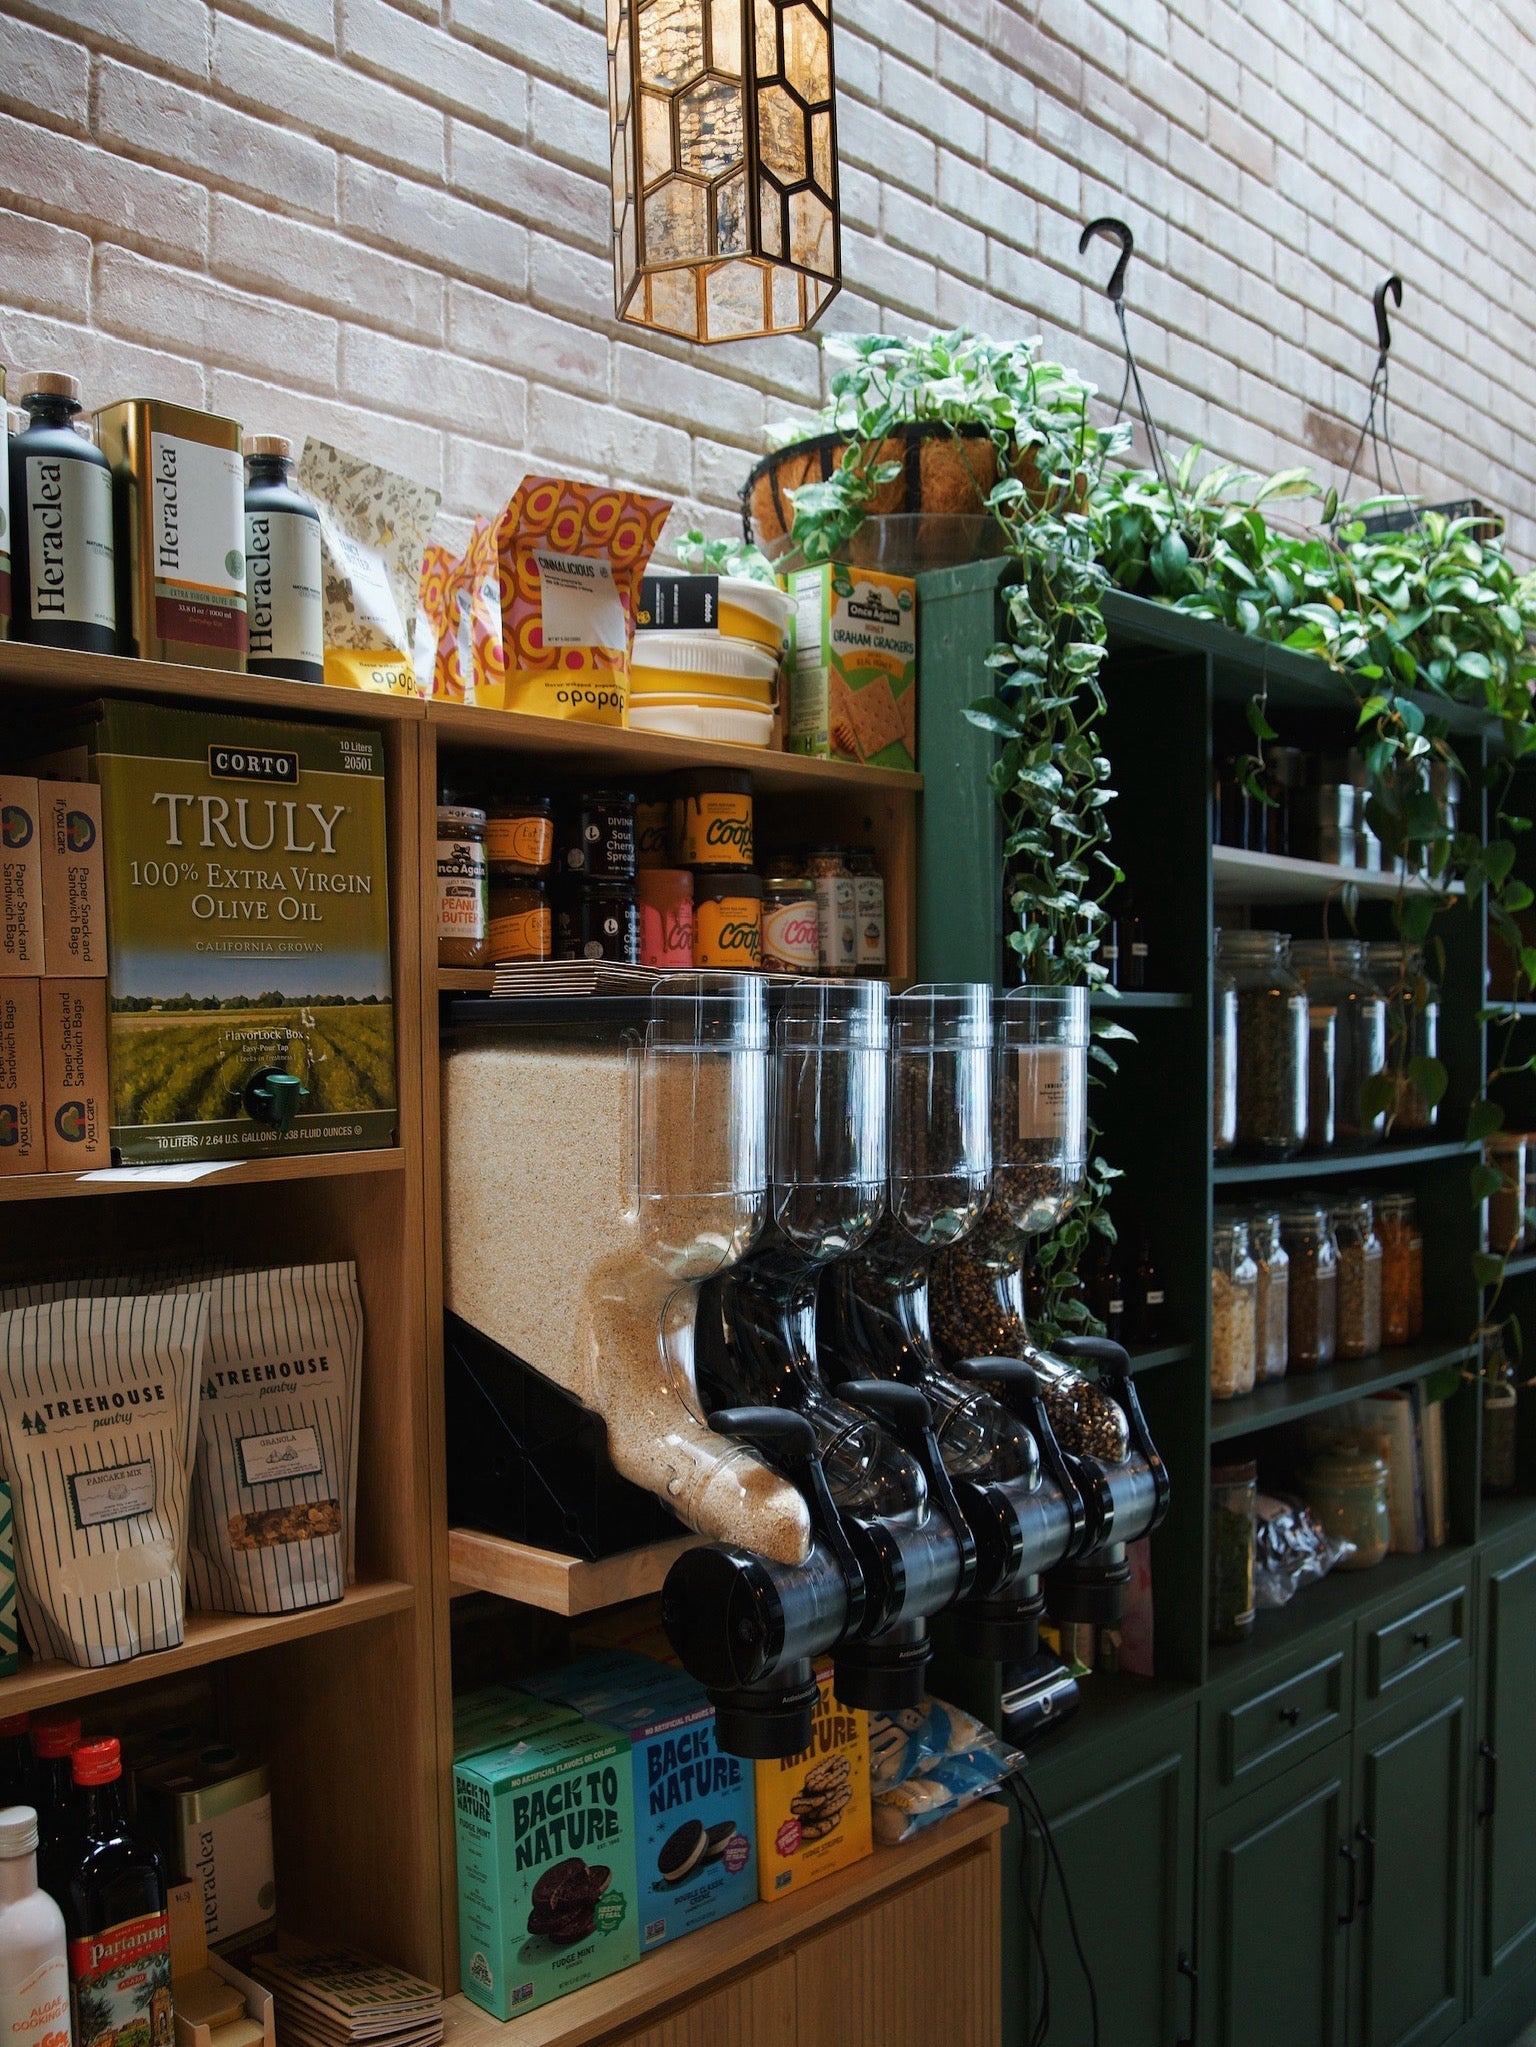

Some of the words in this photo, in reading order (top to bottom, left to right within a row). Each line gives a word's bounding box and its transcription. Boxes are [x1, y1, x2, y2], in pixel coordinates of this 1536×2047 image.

[156, 448, 179, 570] Heraclea
[33, 463, 65, 614] Heraclea
[538, 557, 596, 577] CINNALICIOUS
[246, 517, 273, 654] Heraclea
[850, 604, 872, 618] Once
[873, 607, 898, 623] Again
[834, 629, 871, 647] GRAHAM
[874, 637, 914, 654] CRACKERS
[556, 690, 625, 713] opopop
[340, 741, 350, 751] 10
[351, 742, 373, 753] Liters
[216, 753, 289, 775] CORTO
[344, 757, 373, 771] 20501
[53, 808, 65, 830] you
[152, 792, 345, 854] TRULY
[57, 831, 66, 855] care
[606, 841, 634, 852] Cherry
[438, 864, 459, 874] nce
[461, 864, 485, 876] Again
[606, 852, 635, 864] Spread
[15, 863, 26, 899] Paper
[79, 868, 89, 900] Paper
[130, 861, 198, 887] 100%
[3, 863, 16, 920] Sandwich
[68, 867, 80, 923] Sandwich
[441, 900, 478, 911] PEANUT
[442, 911, 479, 924] BUTTER
[17, 901, 28, 937] Snack
[80, 904, 91, 940] Snack
[4, 924, 17, 953] Bags
[20, 939, 30, 962] and
[69, 926, 80, 955] Bags
[196, 941, 273, 953] CALIFORNIA
[278, 942, 323, 953] GROWN
[83, 942, 93, 962] and
[4, 999, 17, 1029] Bags
[59, 992, 70, 1014] and
[73, 999, 85, 1026] Bags
[61, 1018, 72, 1050] Snack
[225, 1030, 281, 1041] FlavorLock
[285, 1029, 304, 1039] Box
[7, 1031, 17, 1089] Sandwich
[74, 1028, 85, 1087] Sandwich
[277, 1044, 289, 1052] Tap
[63, 1055, 75, 1087] Paper
[20, 1101, 28, 1124] care
[20, 1125, 32, 1147] you
[87, 1123, 98, 1146] you
[158, 1139, 169, 1149] 10
[170, 1136, 198, 1148] LITERS
[206, 1136, 223, 1145] 2.64
[225, 1134, 239, 1144] U.S.
[241, 1132, 277, 1143] GALLONS
[300, 1129, 321, 1139] FLUID
[323, 1127, 352, 1138] OUNCES
[215, 1357, 330, 1387] TREEHOUSE
[44, 1385, 165, 1420] TREEHOUSE
[259, 1381, 298, 1399] pantry
[93, 1411, 134, 1432] pantry
[260, 1436, 297, 1447] GRANOLA
[86, 1472, 126, 1486] PANCAKE
[127, 1469, 142, 1478] MIX
[644, 1727, 654, 1736] NO
[655, 1716, 684, 1733] ARTIFICIAL
[685, 1708, 709, 1723] FLAVORS
[780, 1716, 857, 1772] TURE
[511, 1778, 521, 1787] NO
[522, 1768, 556, 1784] ARTIFICIAL
[557, 1757, 584, 1773] FLAVORS
[585, 1753, 593, 1762] OR
[594, 1746, 617, 1760] COLORS
[647, 1727, 709, 1788] BACK
[456, 1776, 478, 1799] BACK
[479, 1787, 490, 1808] TO
[649, 1757, 742, 1816] NATURE
[457, 1796, 491, 1823] NATURE
[513, 1776, 583, 1843] BACK
[586, 1766, 618, 1806] TO
[515, 1808, 620, 1872] NATURE
[196, 1830, 218, 1935] Heraclea
[90, 1924, 166, 1969] Partanna
[551, 1952, 577, 1970] FUDGE
[577, 1945, 596, 1959] MINT
[30, 1994, 62, 2018] ALGAE
[12, 2007, 61, 2032] COOKING
